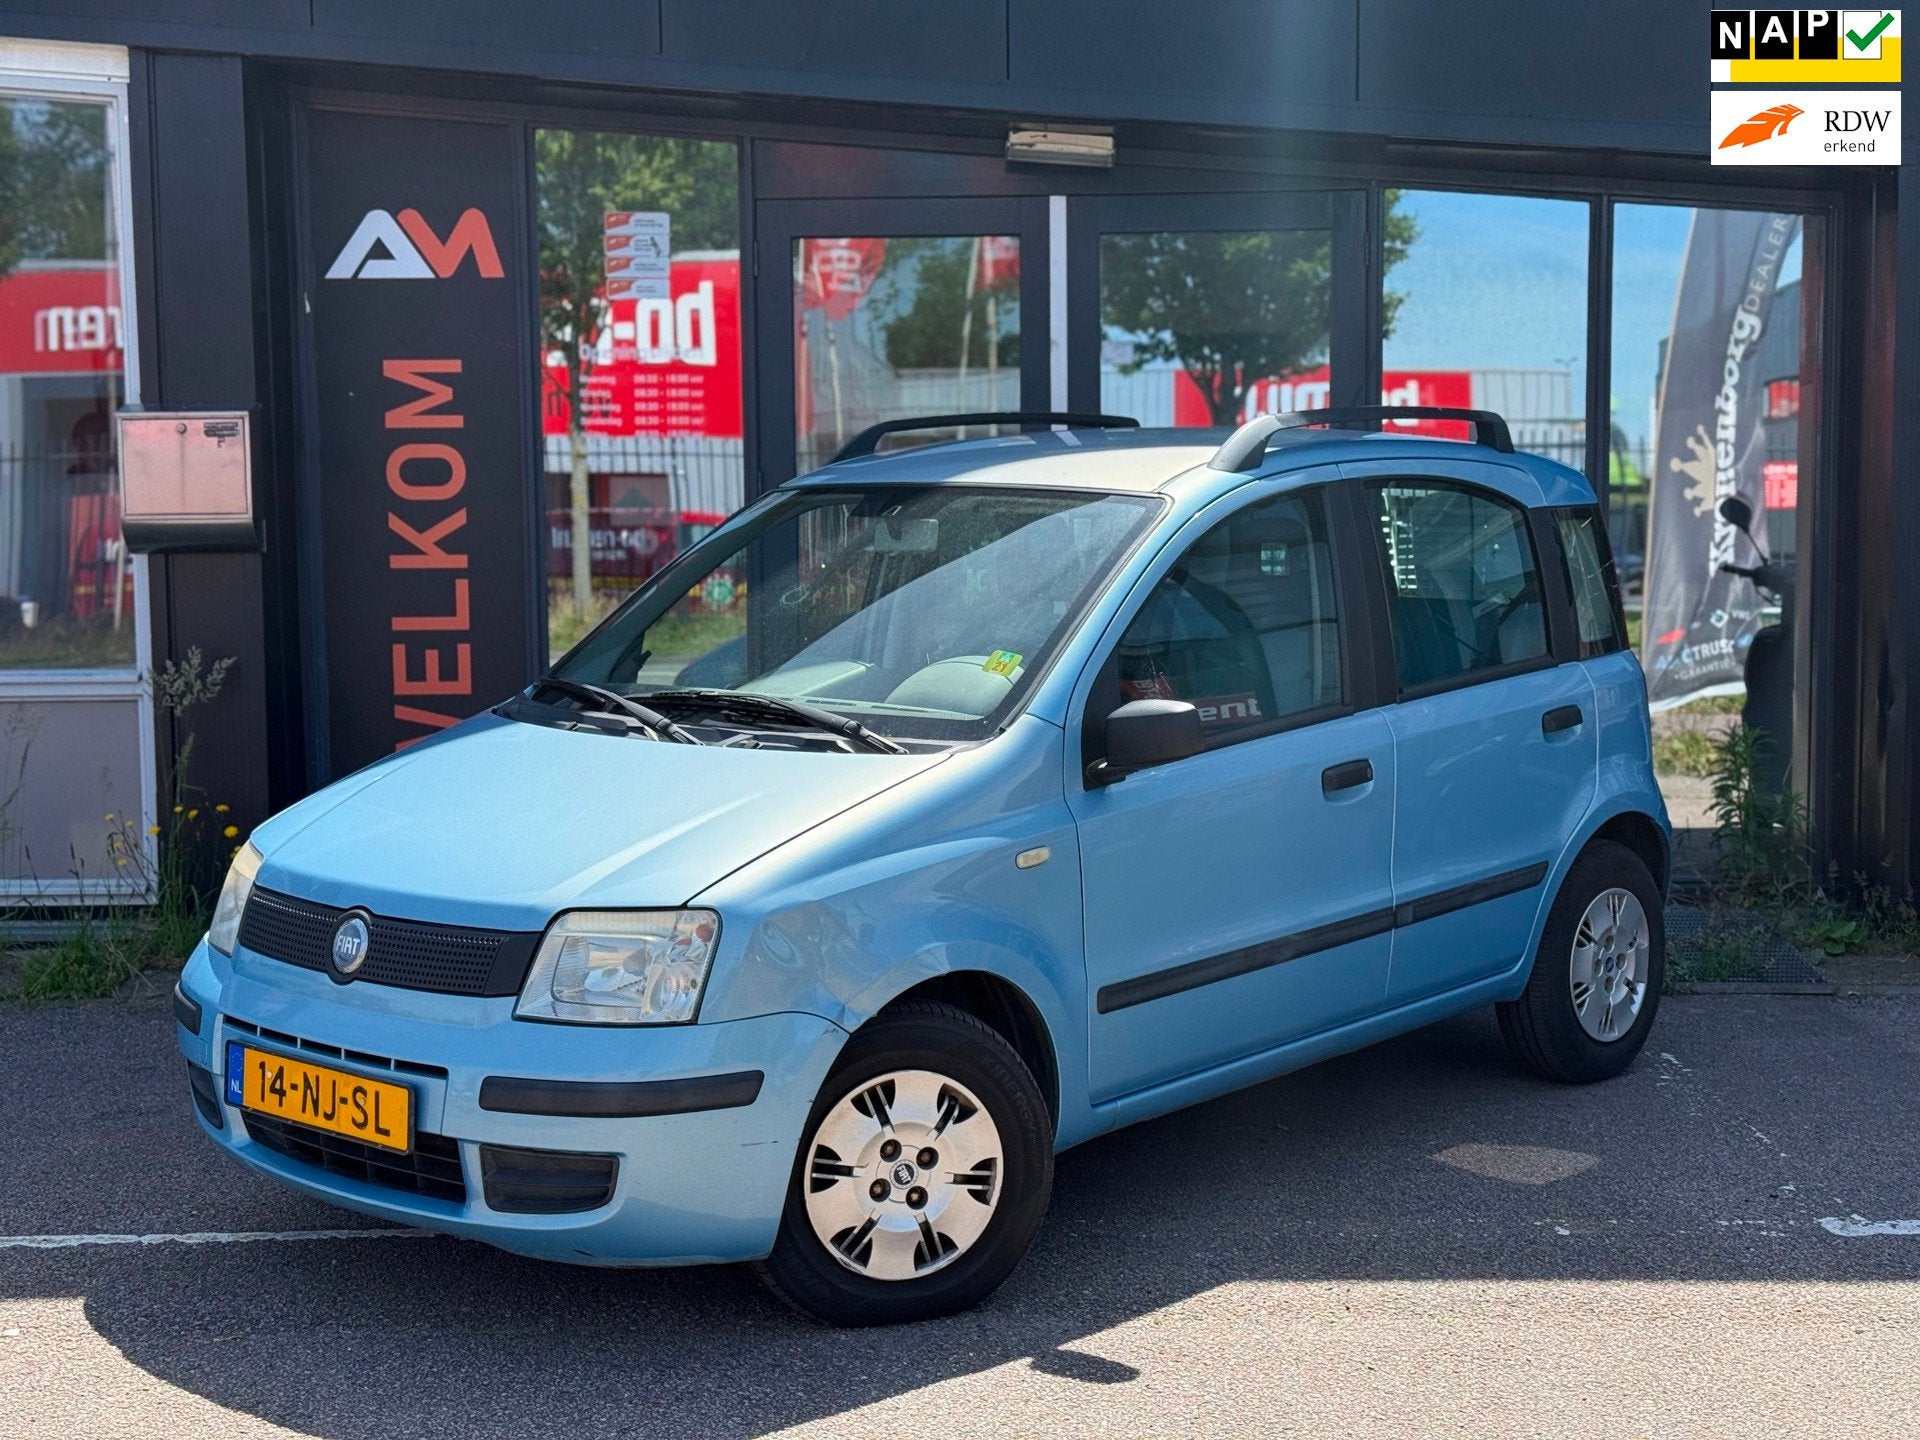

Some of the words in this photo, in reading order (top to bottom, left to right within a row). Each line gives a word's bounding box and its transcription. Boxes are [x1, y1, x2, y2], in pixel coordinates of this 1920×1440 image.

[335, 934, 360, 955] FIAT
[230, 1078, 242, 1094] NL
[258, 1060, 391, 1137] 14-NJ-SL
[896, 1164, 912, 1184] FIAT
